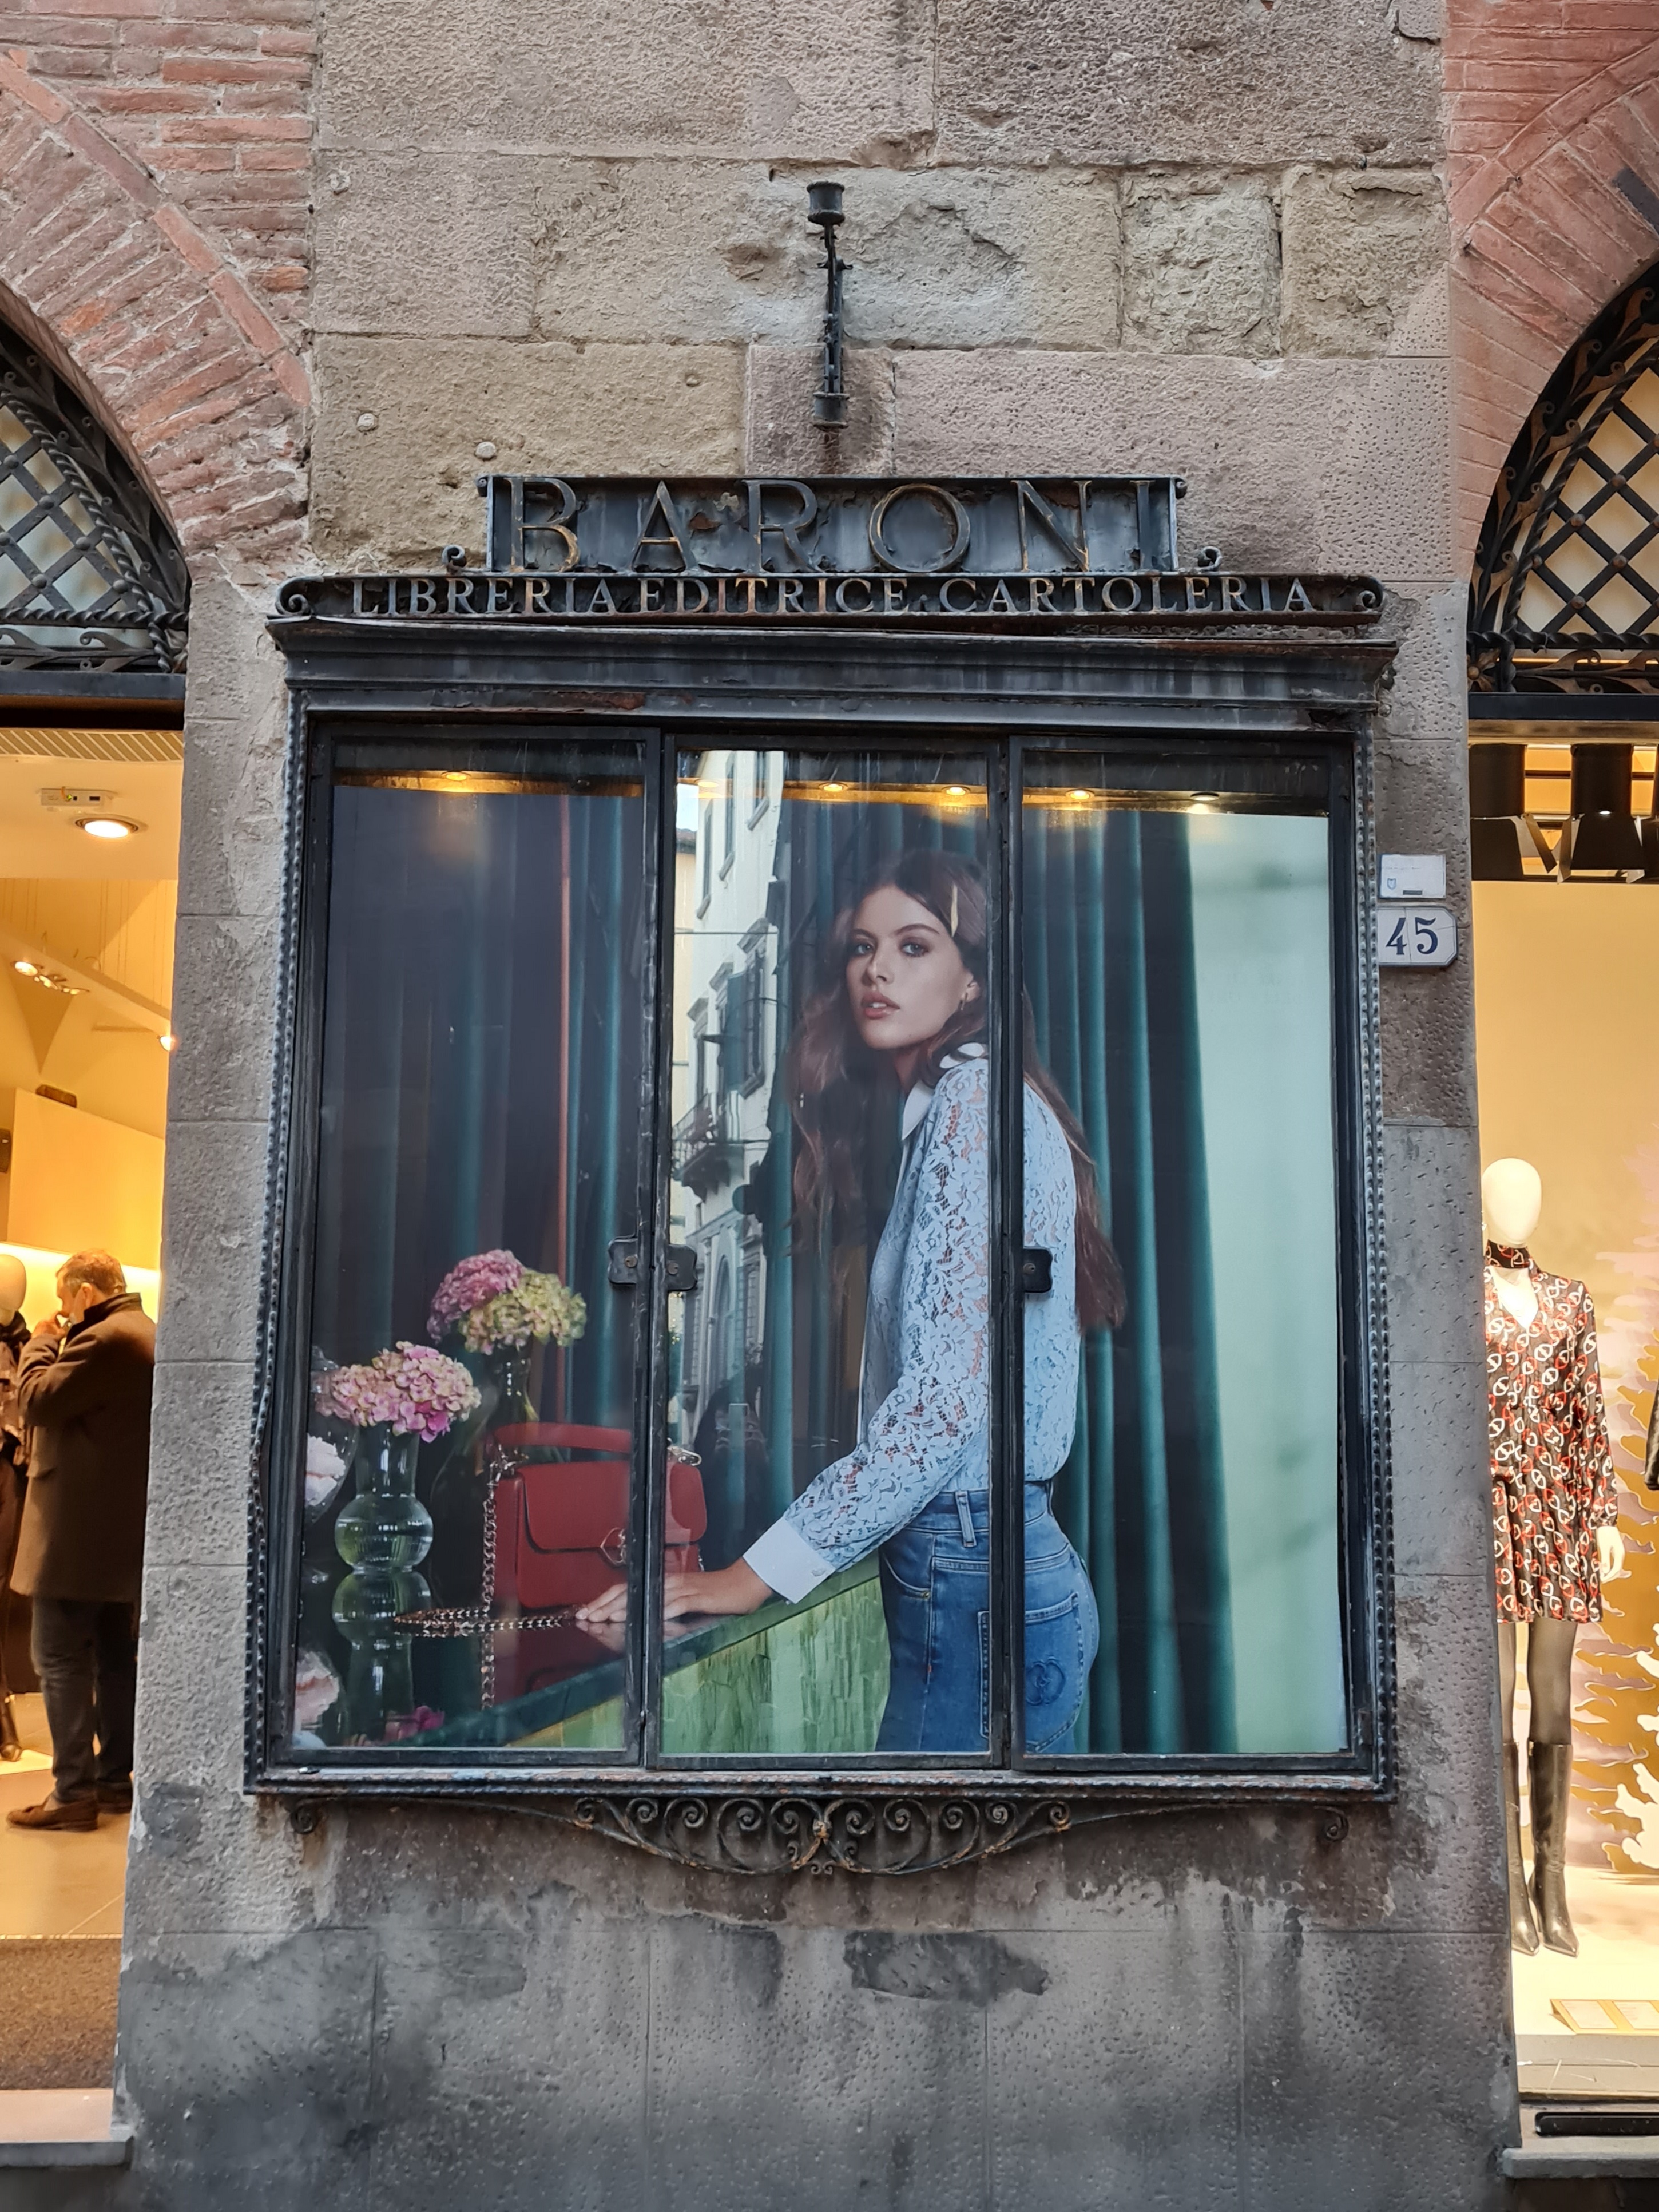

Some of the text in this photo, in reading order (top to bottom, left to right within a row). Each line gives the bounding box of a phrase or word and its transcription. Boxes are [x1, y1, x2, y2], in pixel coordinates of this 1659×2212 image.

[508, 477, 1149, 572] BARONI
[351, 577, 617, 615] LIBRERIA
[940, 577, 1315, 614] CARTOLERIA
[1386, 917, 1438, 955] 45
